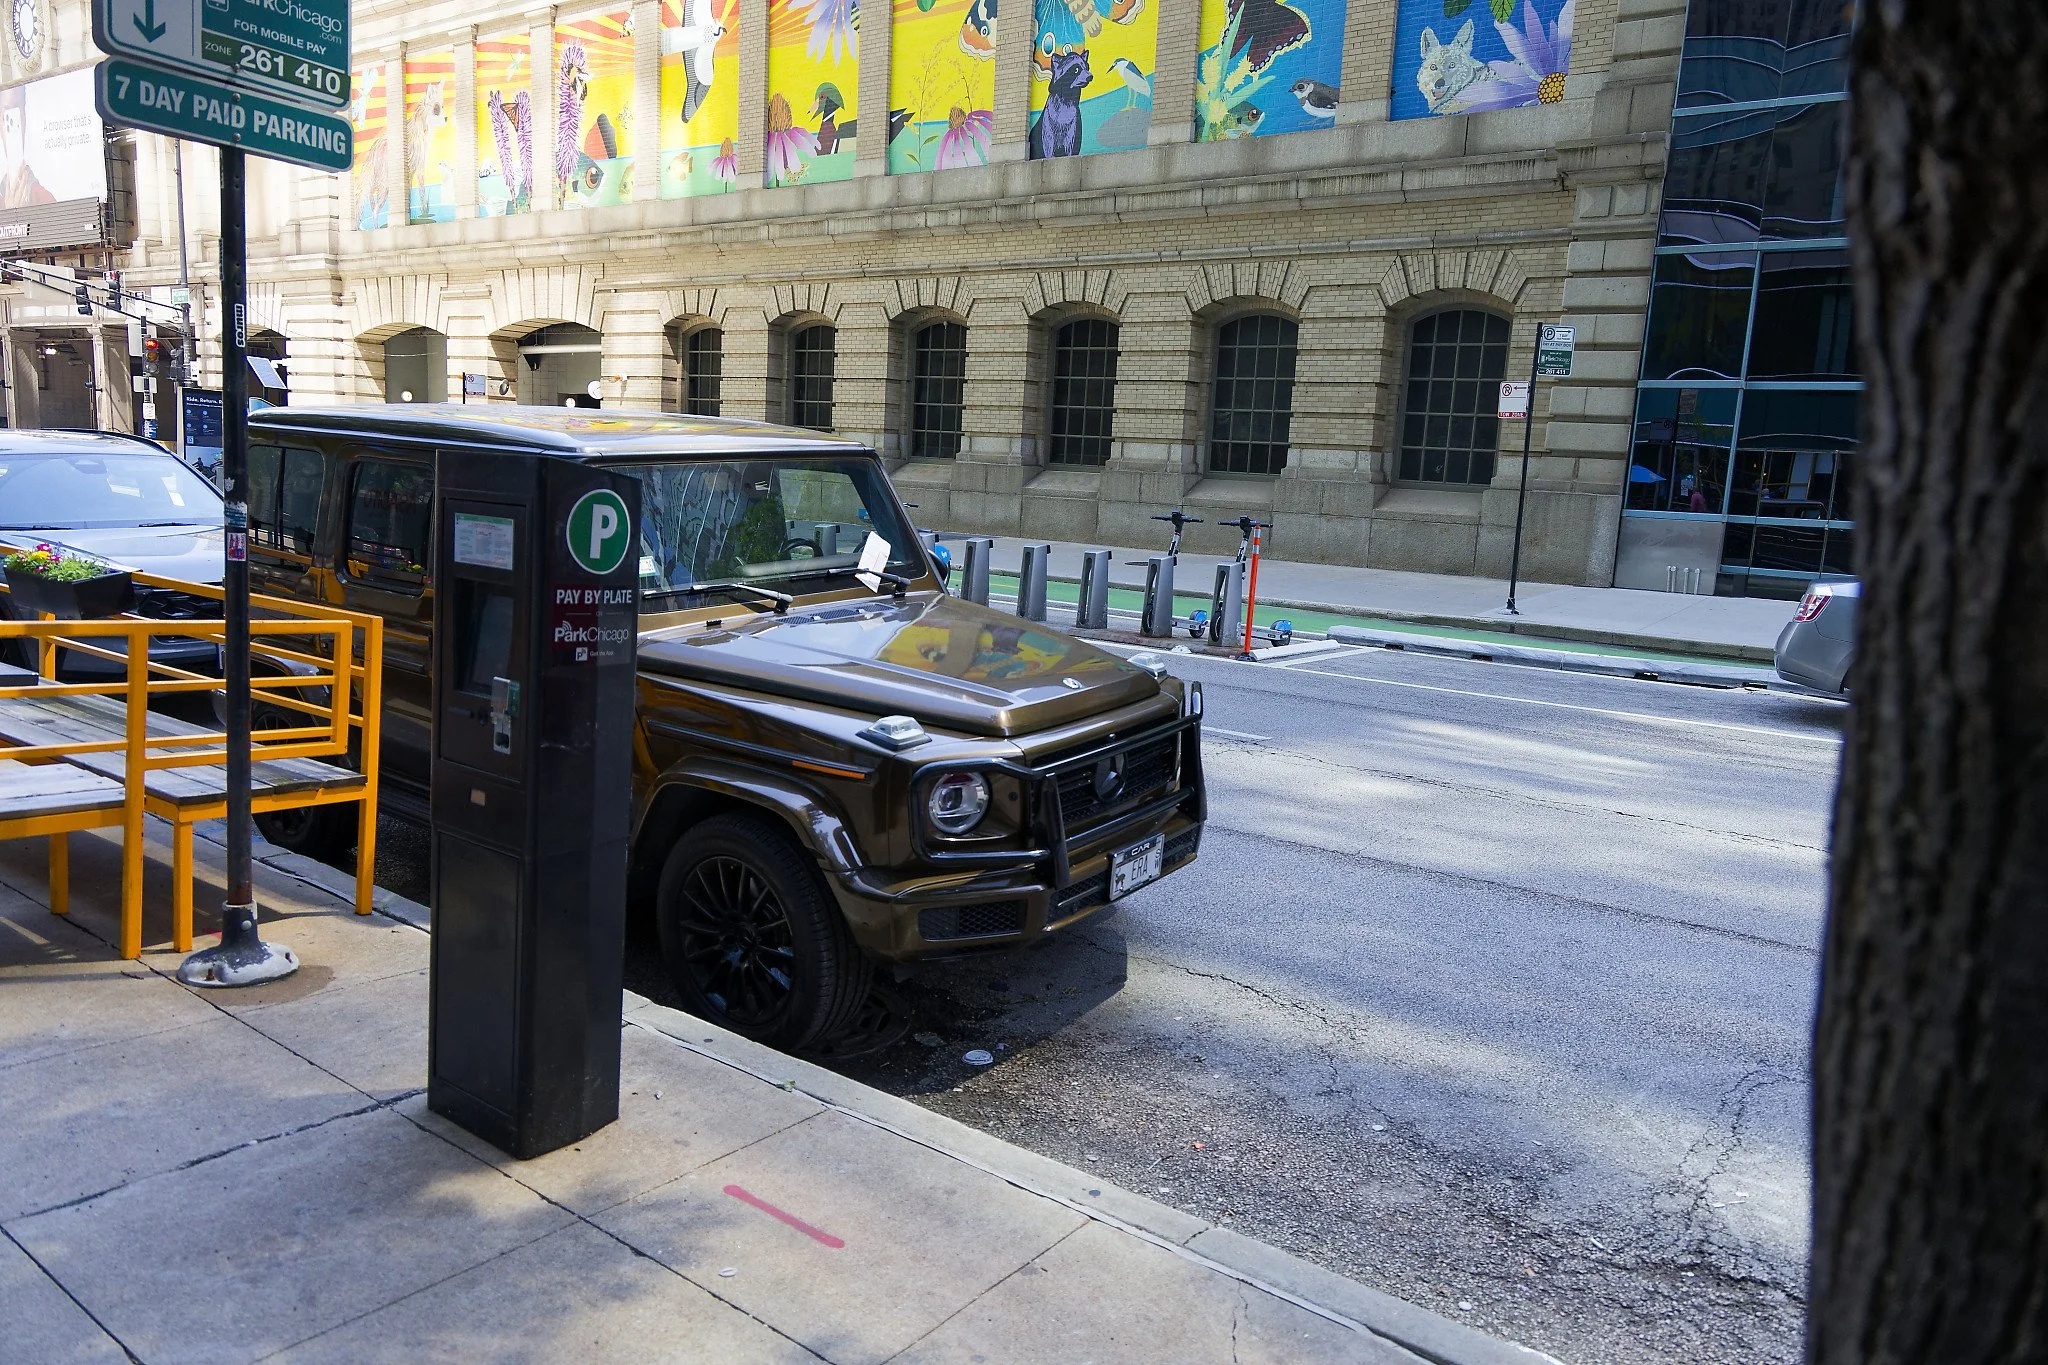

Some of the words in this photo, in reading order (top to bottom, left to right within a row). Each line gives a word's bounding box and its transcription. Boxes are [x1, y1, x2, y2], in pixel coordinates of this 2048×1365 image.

[234, 19, 258, 35] FOR
[260, 27, 304, 49] MOBILE
[306, 41, 327, 56] PAY
[319, 32, 342, 45] .com
[205, 41, 232, 56] ZONE
[240, 45, 284, 77] 261
[295, 63, 341, 94] 410
[115, 75, 131, 99] 7
[139, 81, 185, 113] DAY
[193, 94, 246, 129] PAID
[253, 110, 346, 155] PARKING
[235, 304, 245, 347] muros
[556, 589, 581, 604] PAY
[584, 590, 601, 604] BY
[603, 589, 632, 604] PLATE
[554, 626, 629, 643] ParkChicago
[1131, 843, 1150, 856] CAR
